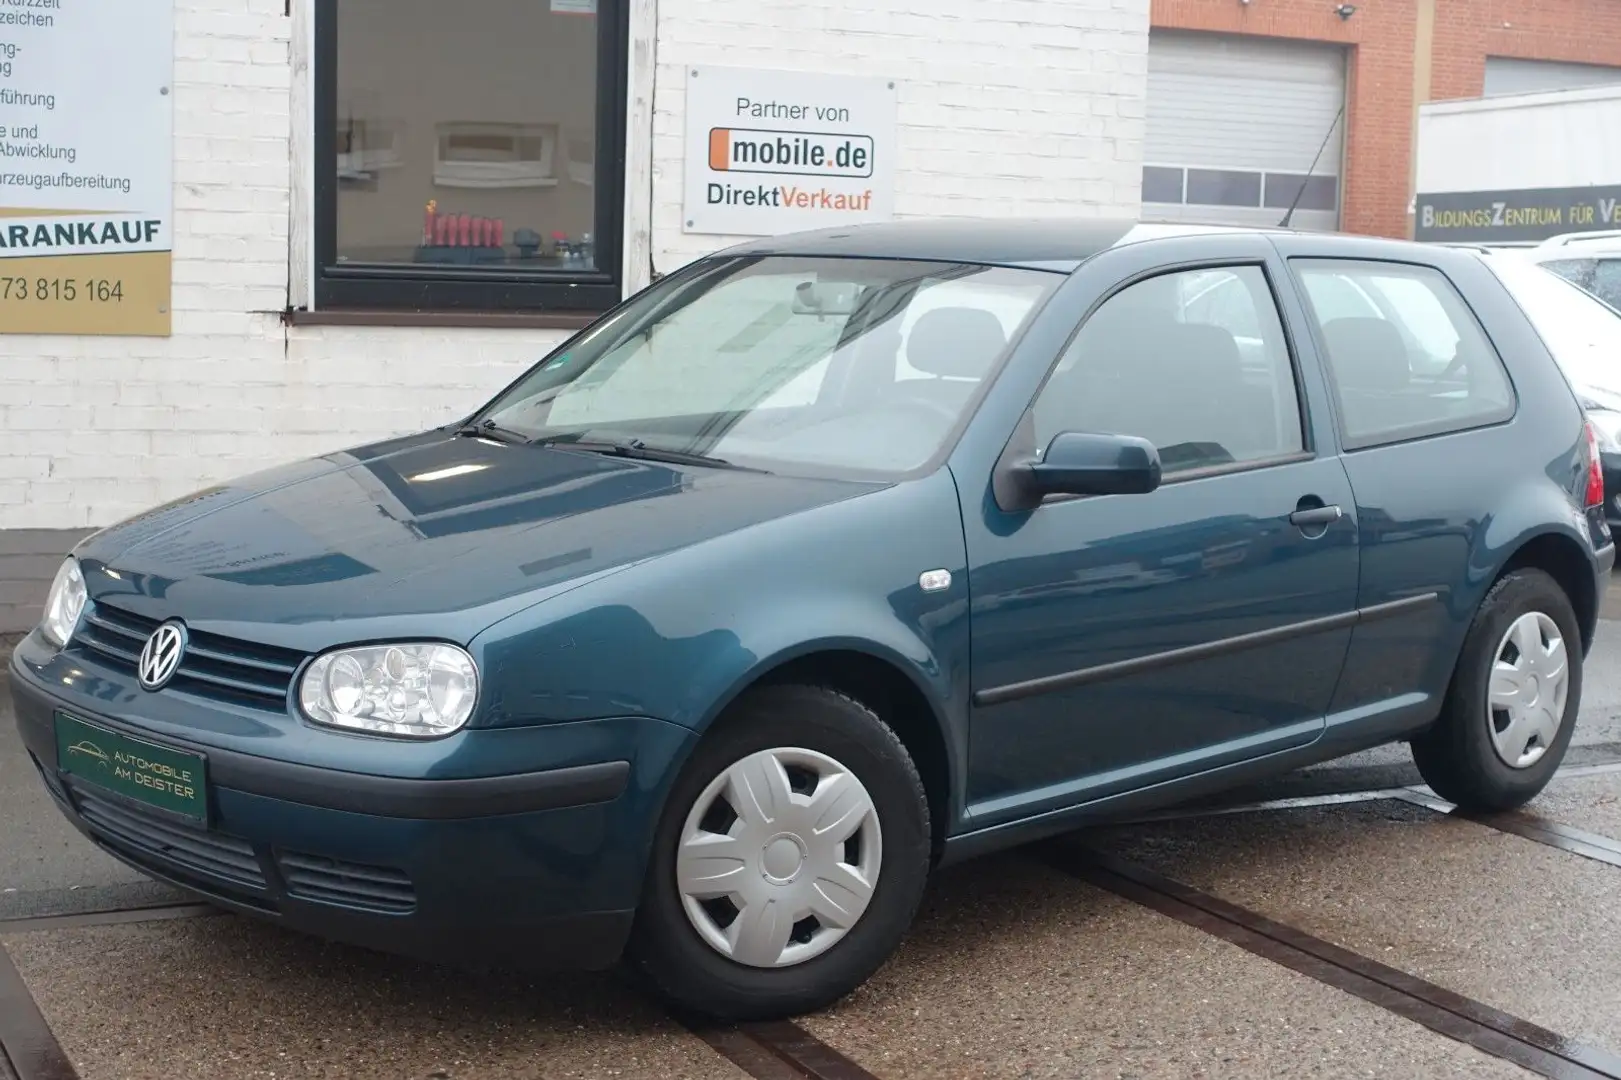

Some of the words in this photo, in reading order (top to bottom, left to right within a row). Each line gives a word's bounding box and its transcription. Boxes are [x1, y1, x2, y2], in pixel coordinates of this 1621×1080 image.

[0, 88, 55, 110] führung
[736, 97, 809, 120] Partner
[815, 106, 849, 122] von
[11, 124, 38, 139] und
[733, 137, 867, 169] mobile.de
[0, 172, 131, 193] rzeugaufbereitung
[707, 183, 872, 211] DirektVerkauf
[36, 278, 76, 302] 815
[86, 280, 124, 303] 164
[114, 750, 192, 783] AUTOMOBILE
[114, 766, 131, 781] AM
[134, 772, 195, 799] DEISTER
